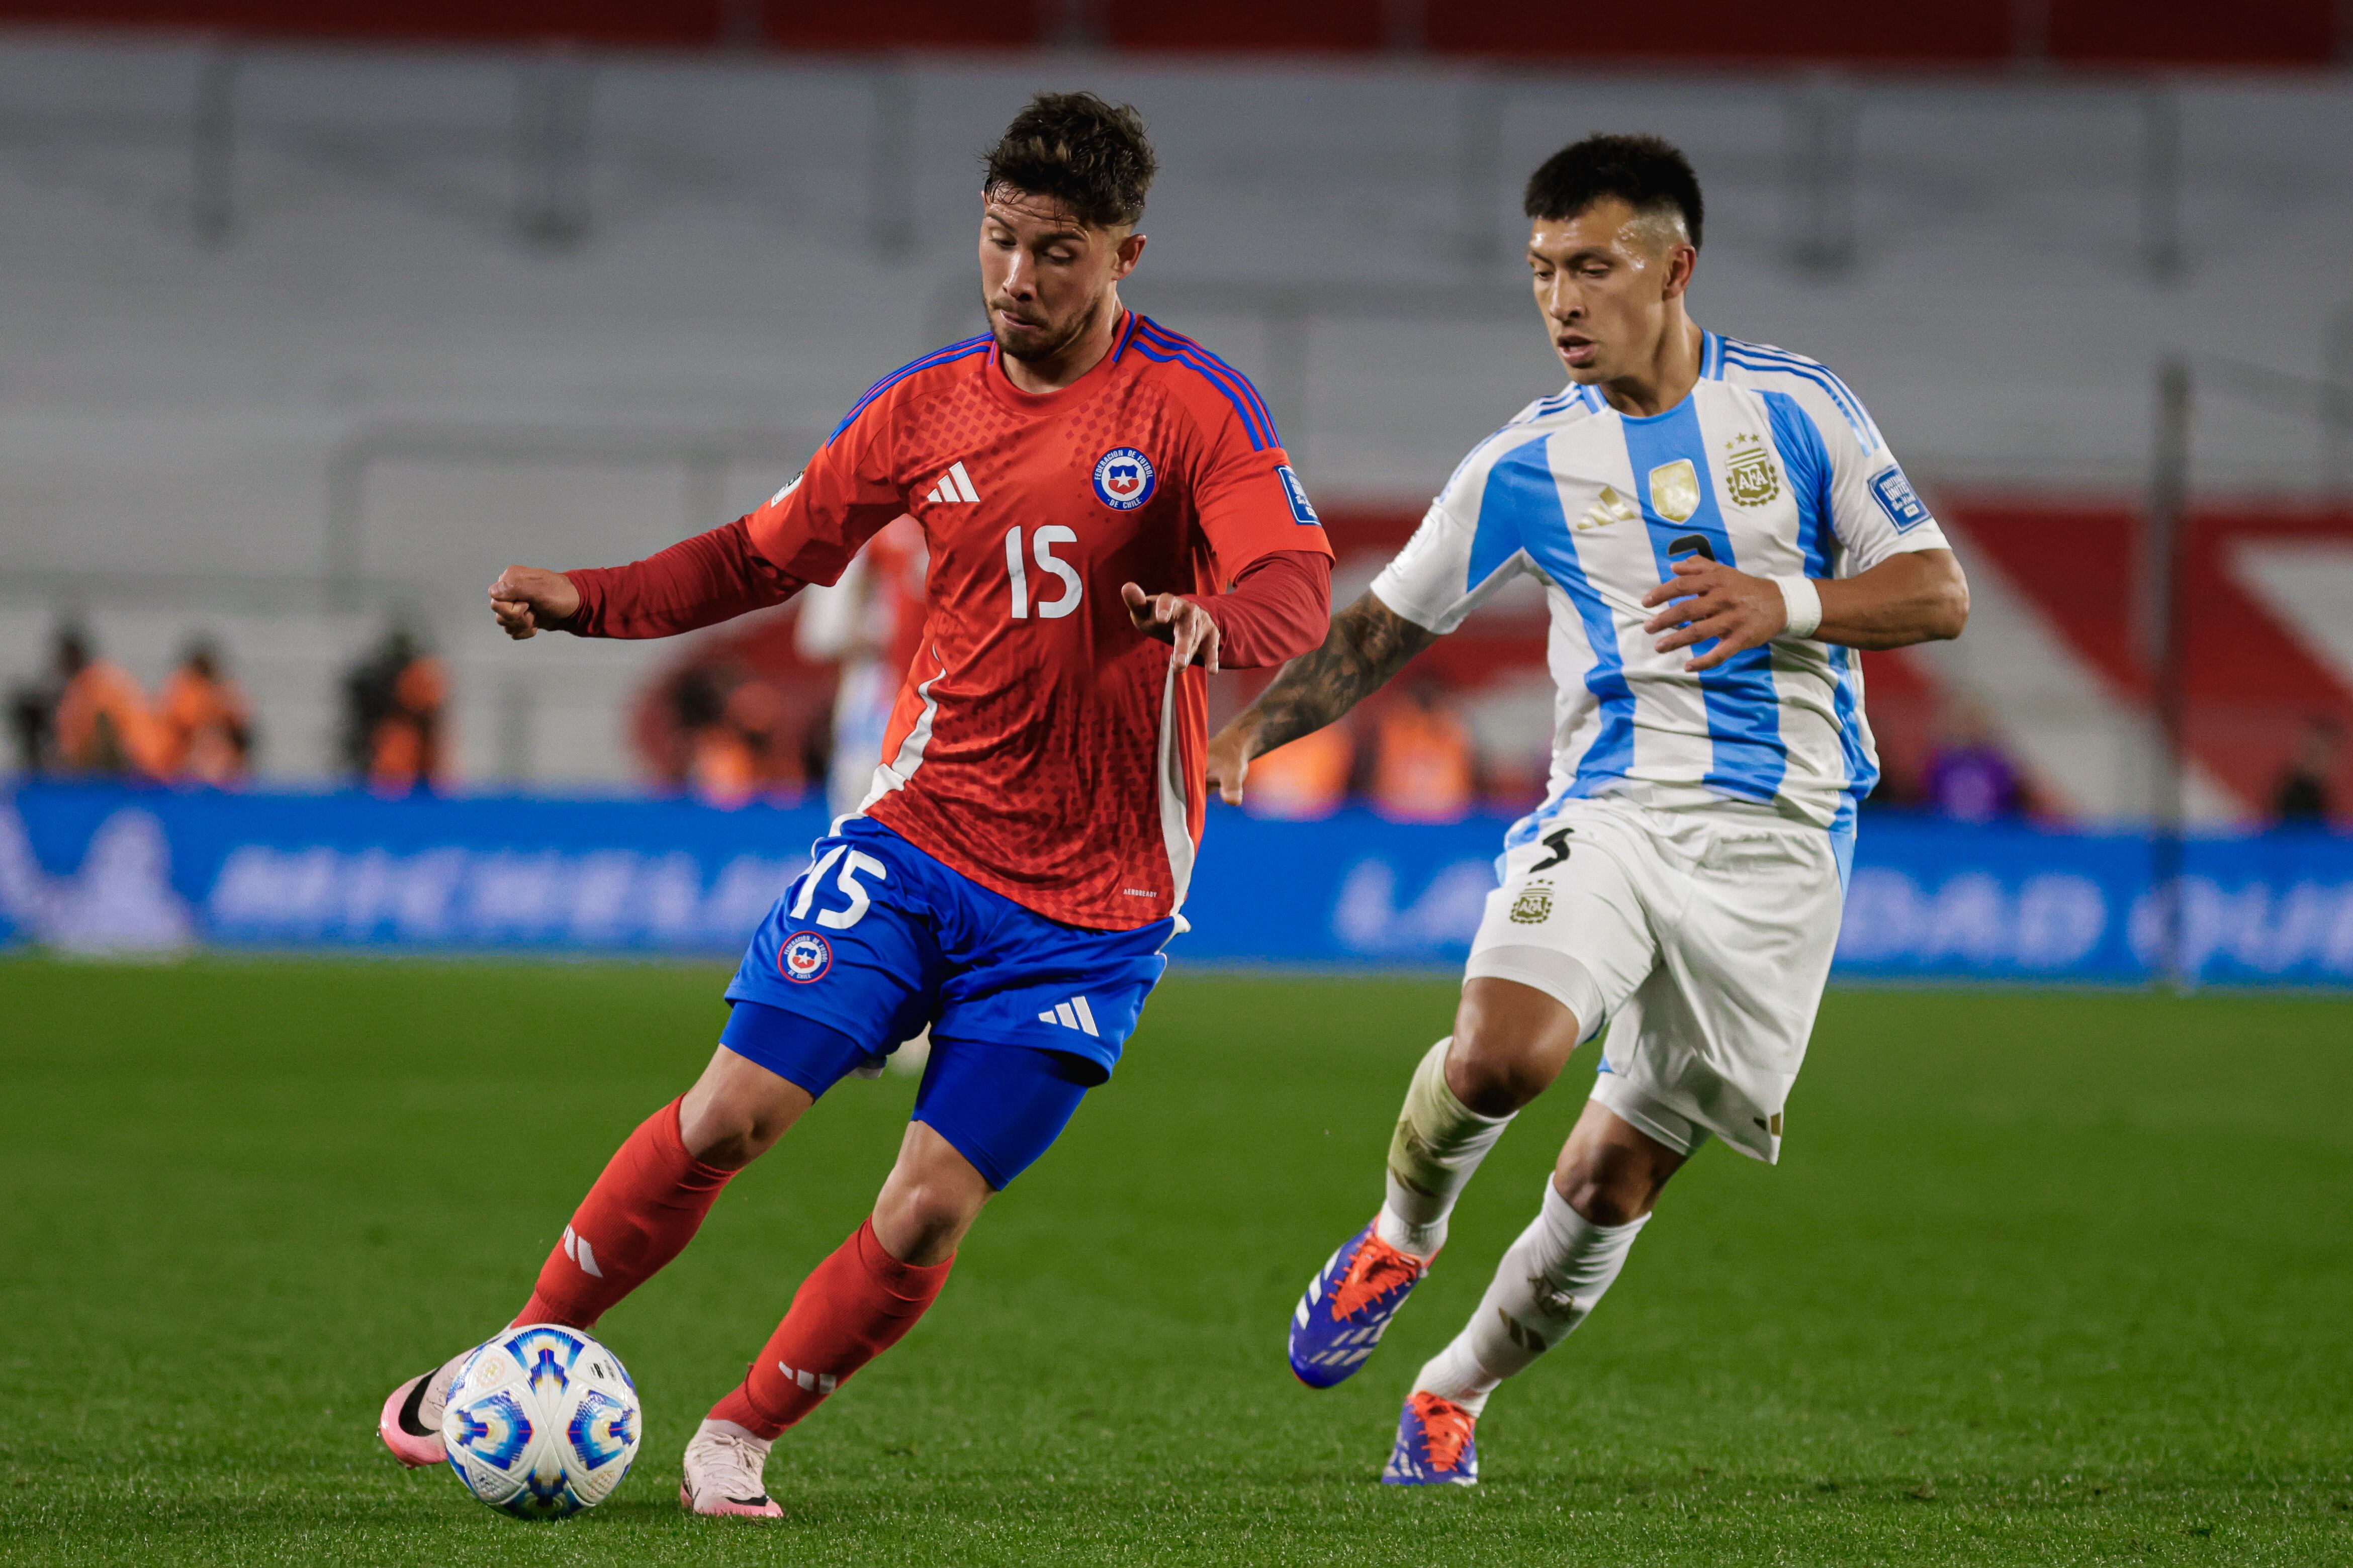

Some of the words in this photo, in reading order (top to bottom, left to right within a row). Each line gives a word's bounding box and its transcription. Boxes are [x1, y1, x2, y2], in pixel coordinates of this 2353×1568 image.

[1094, 449, 1124, 481] FEDERACION
[1127, 449, 1137, 457] DE
[1137, 455, 1153, 479] FUTBOL
[1738, 464, 1768, 491] AFA
[1109, 499, 1119, 508] DE
[1123, 497, 1142, 509] CHILE
[1005, 524, 1083, 619] 15
[789, 844, 887, 930] 15
